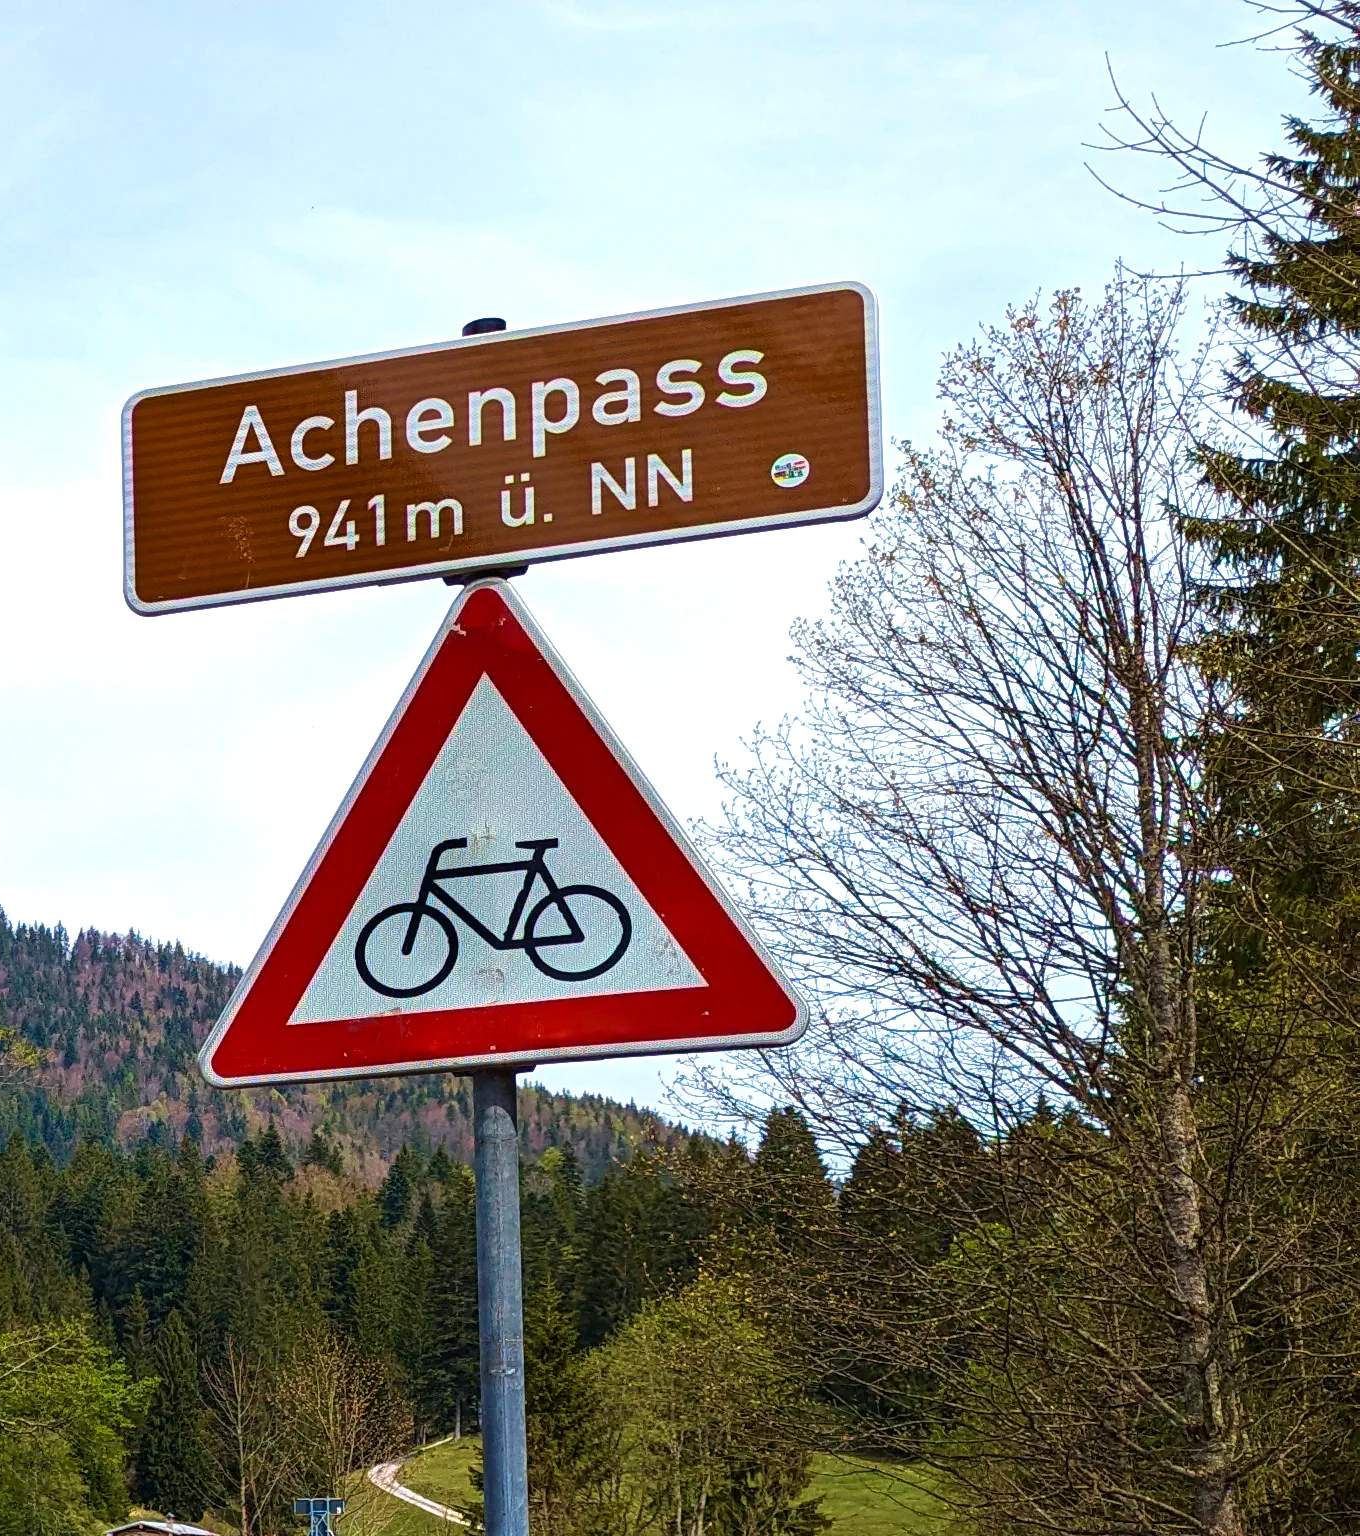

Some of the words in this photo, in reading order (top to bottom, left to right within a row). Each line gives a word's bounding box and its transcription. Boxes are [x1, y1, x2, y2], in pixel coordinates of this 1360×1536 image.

[219, 349, 768, 485] Achenpass
[287, 496, 465, 559] 941m
[500, 474, 553, 528] ü.
[591, 448, 694, 515] NN
